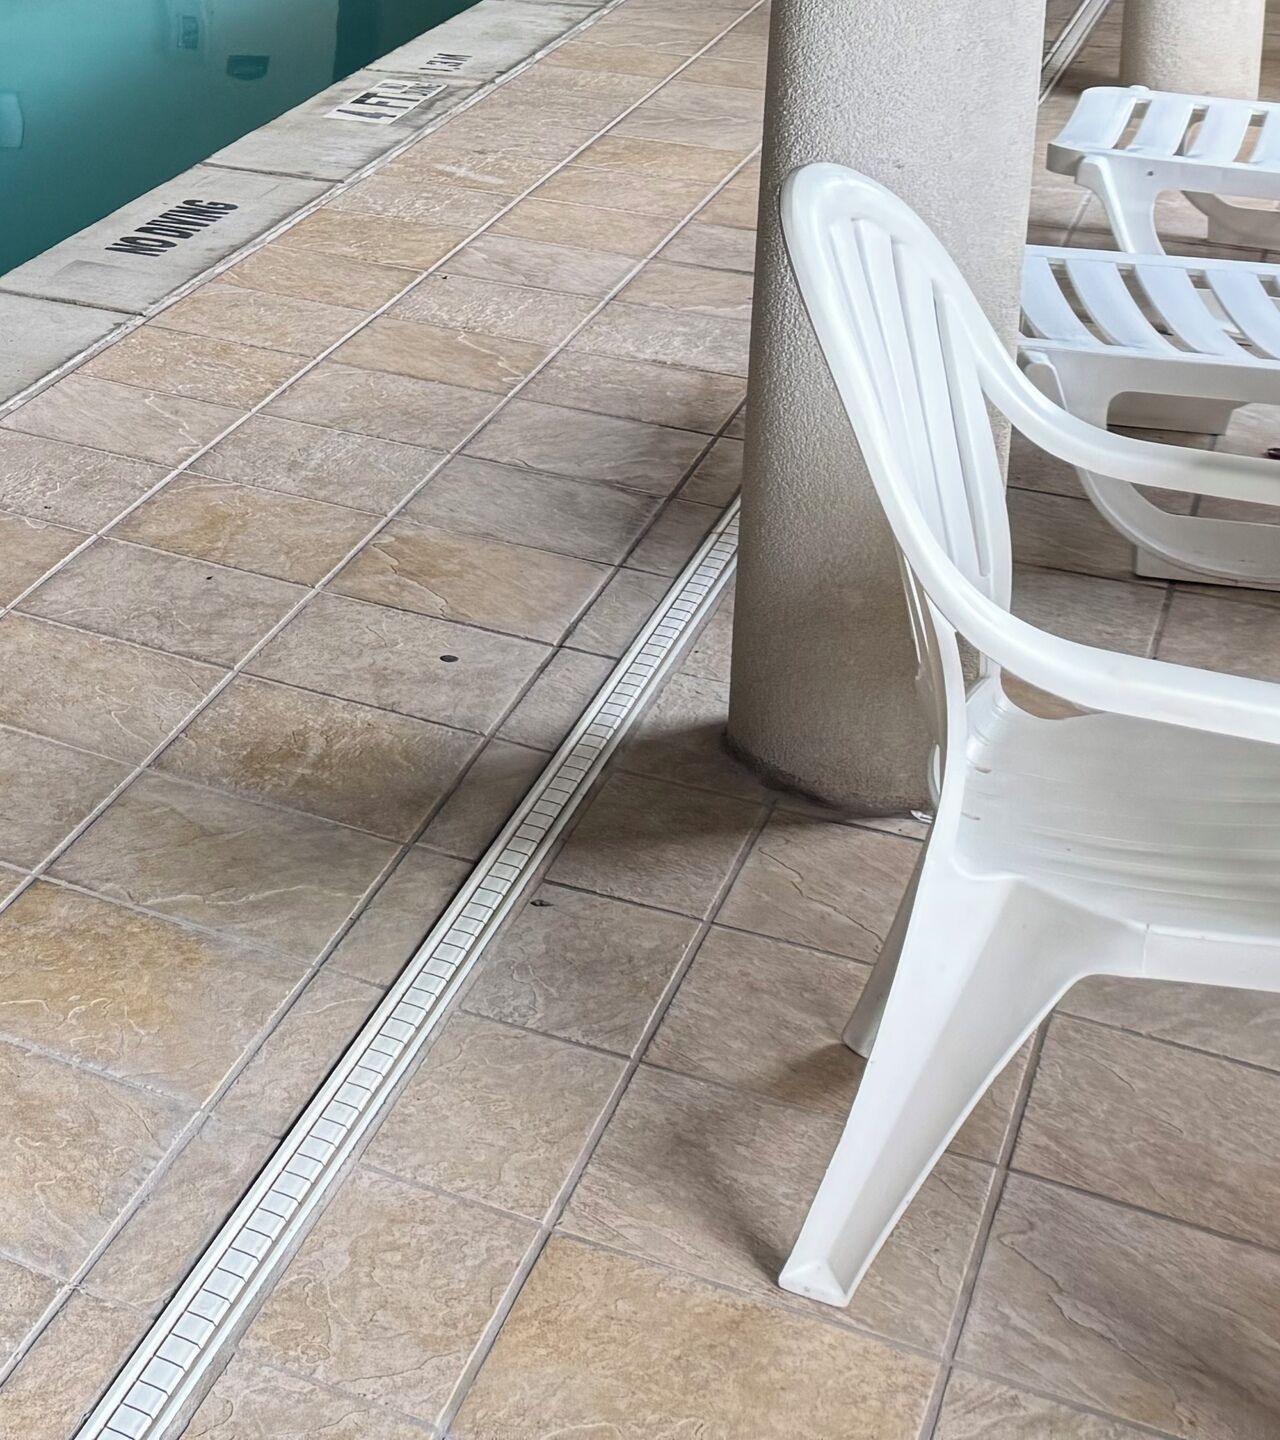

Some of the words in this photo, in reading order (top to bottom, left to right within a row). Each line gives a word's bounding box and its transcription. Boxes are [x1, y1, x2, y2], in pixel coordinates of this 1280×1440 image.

[350, 92, 420, 109] FT
[134, 199, 238, 239] DIVING
[104, 236, 178, 257] NO
